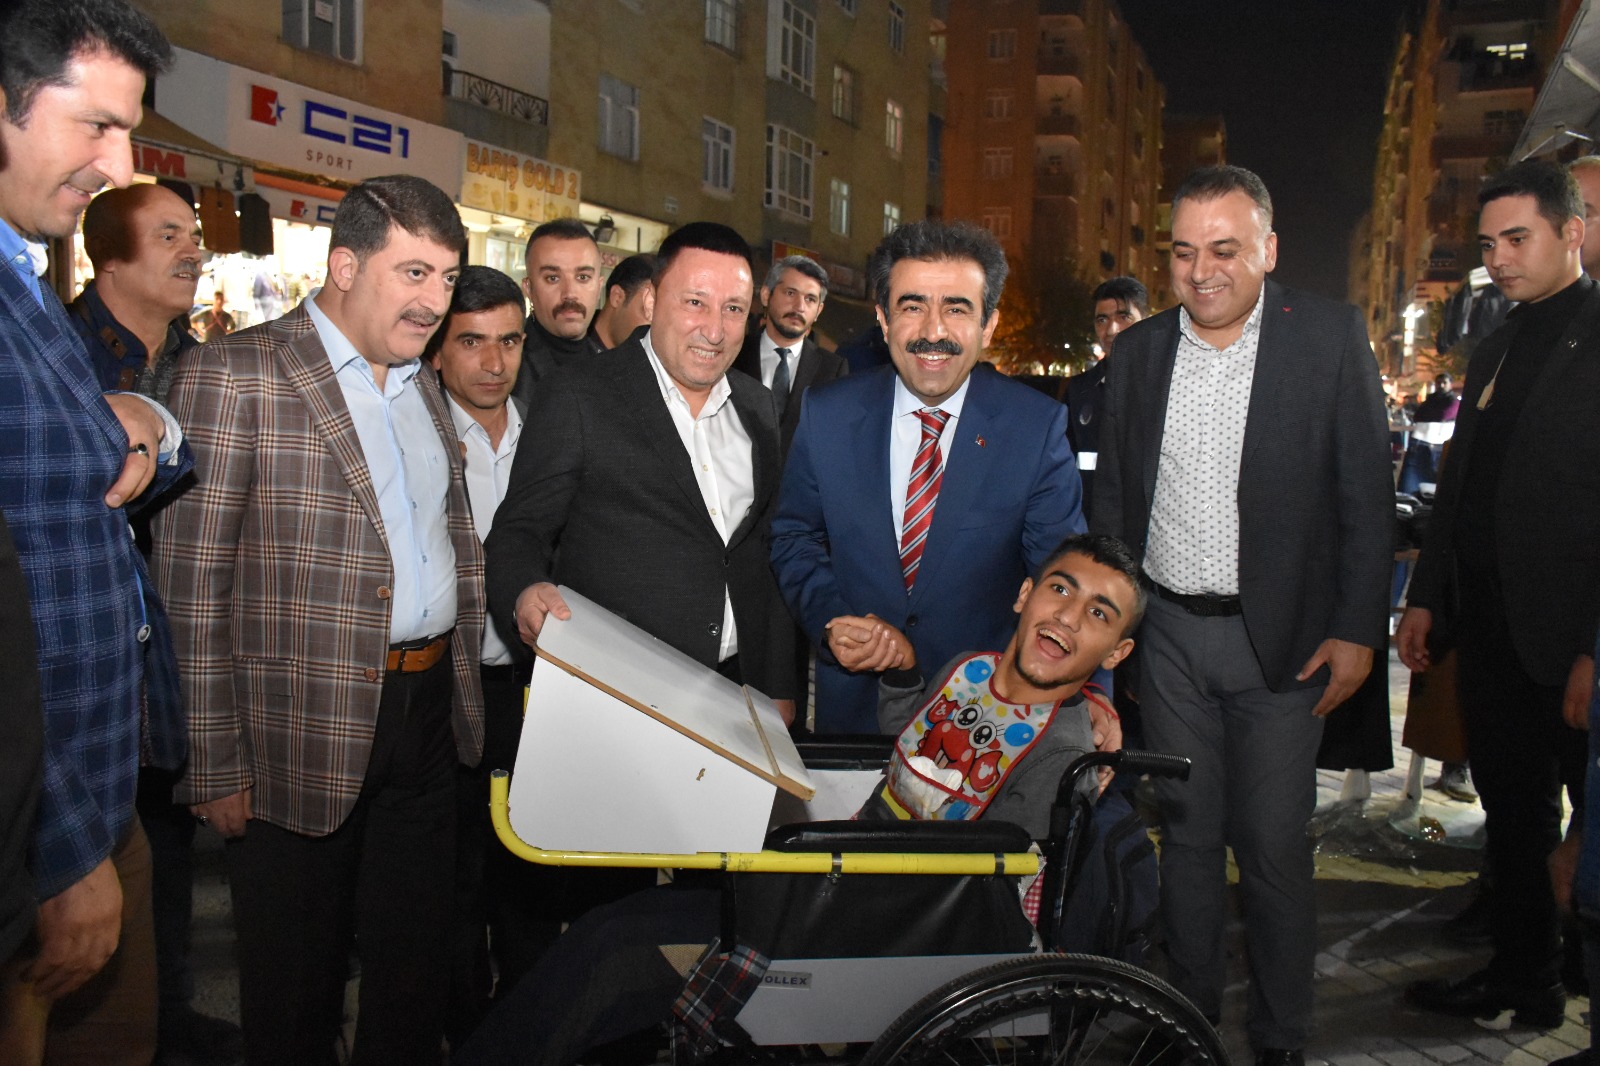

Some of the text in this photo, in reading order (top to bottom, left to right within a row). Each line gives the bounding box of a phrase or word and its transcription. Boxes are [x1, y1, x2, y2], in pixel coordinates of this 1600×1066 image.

[304, 100, 410, 159] C21
[305, 149, 354, 171] SPORT
[522, 159, 565, 196] GOLD
[567, 172, 578, 200] 2
[764, 975, 808, 986] OLLEX
